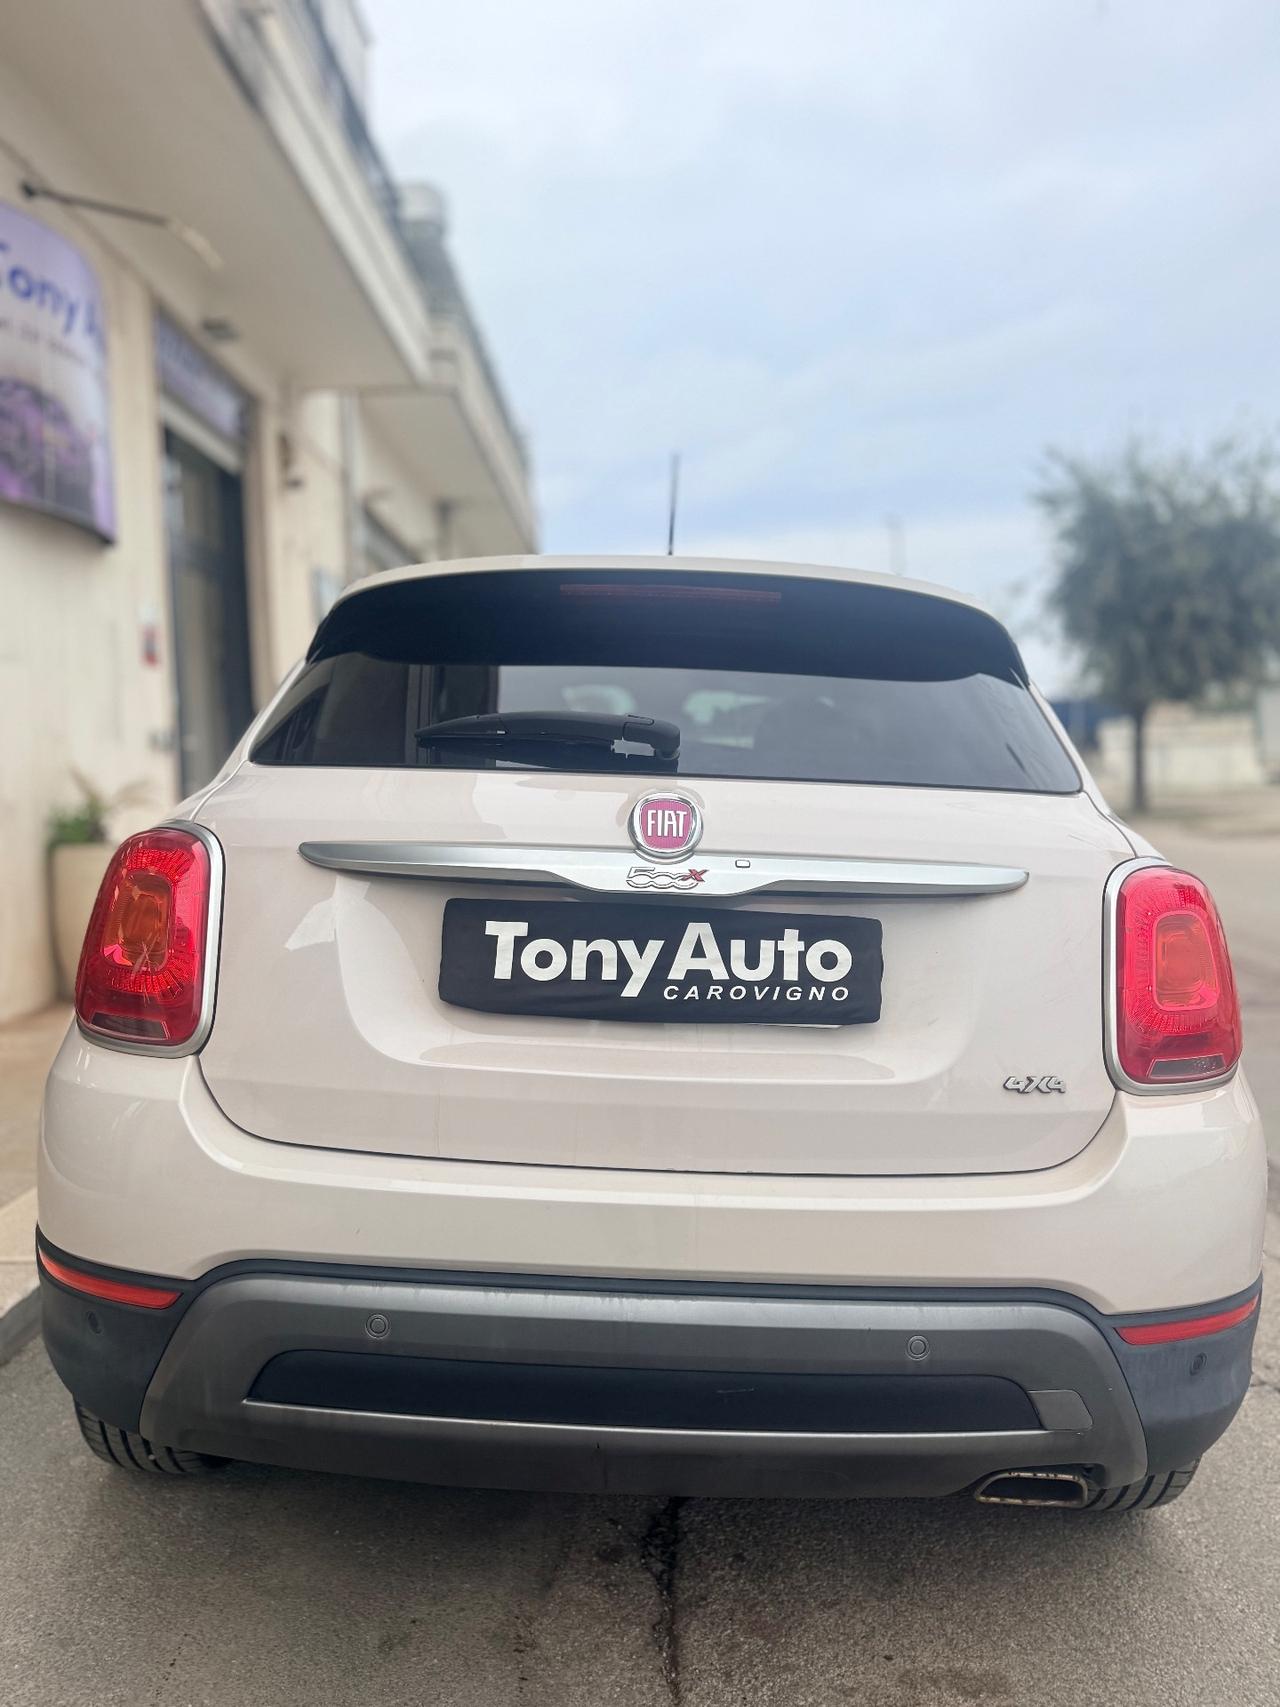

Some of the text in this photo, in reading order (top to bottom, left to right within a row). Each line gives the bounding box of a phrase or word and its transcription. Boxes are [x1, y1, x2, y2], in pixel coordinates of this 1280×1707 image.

[647, 809, 688, 838] FIAT
[485, 920, 853, 998] Tony Auto
[663, 985, 850, 1002] CAROVIGNO
